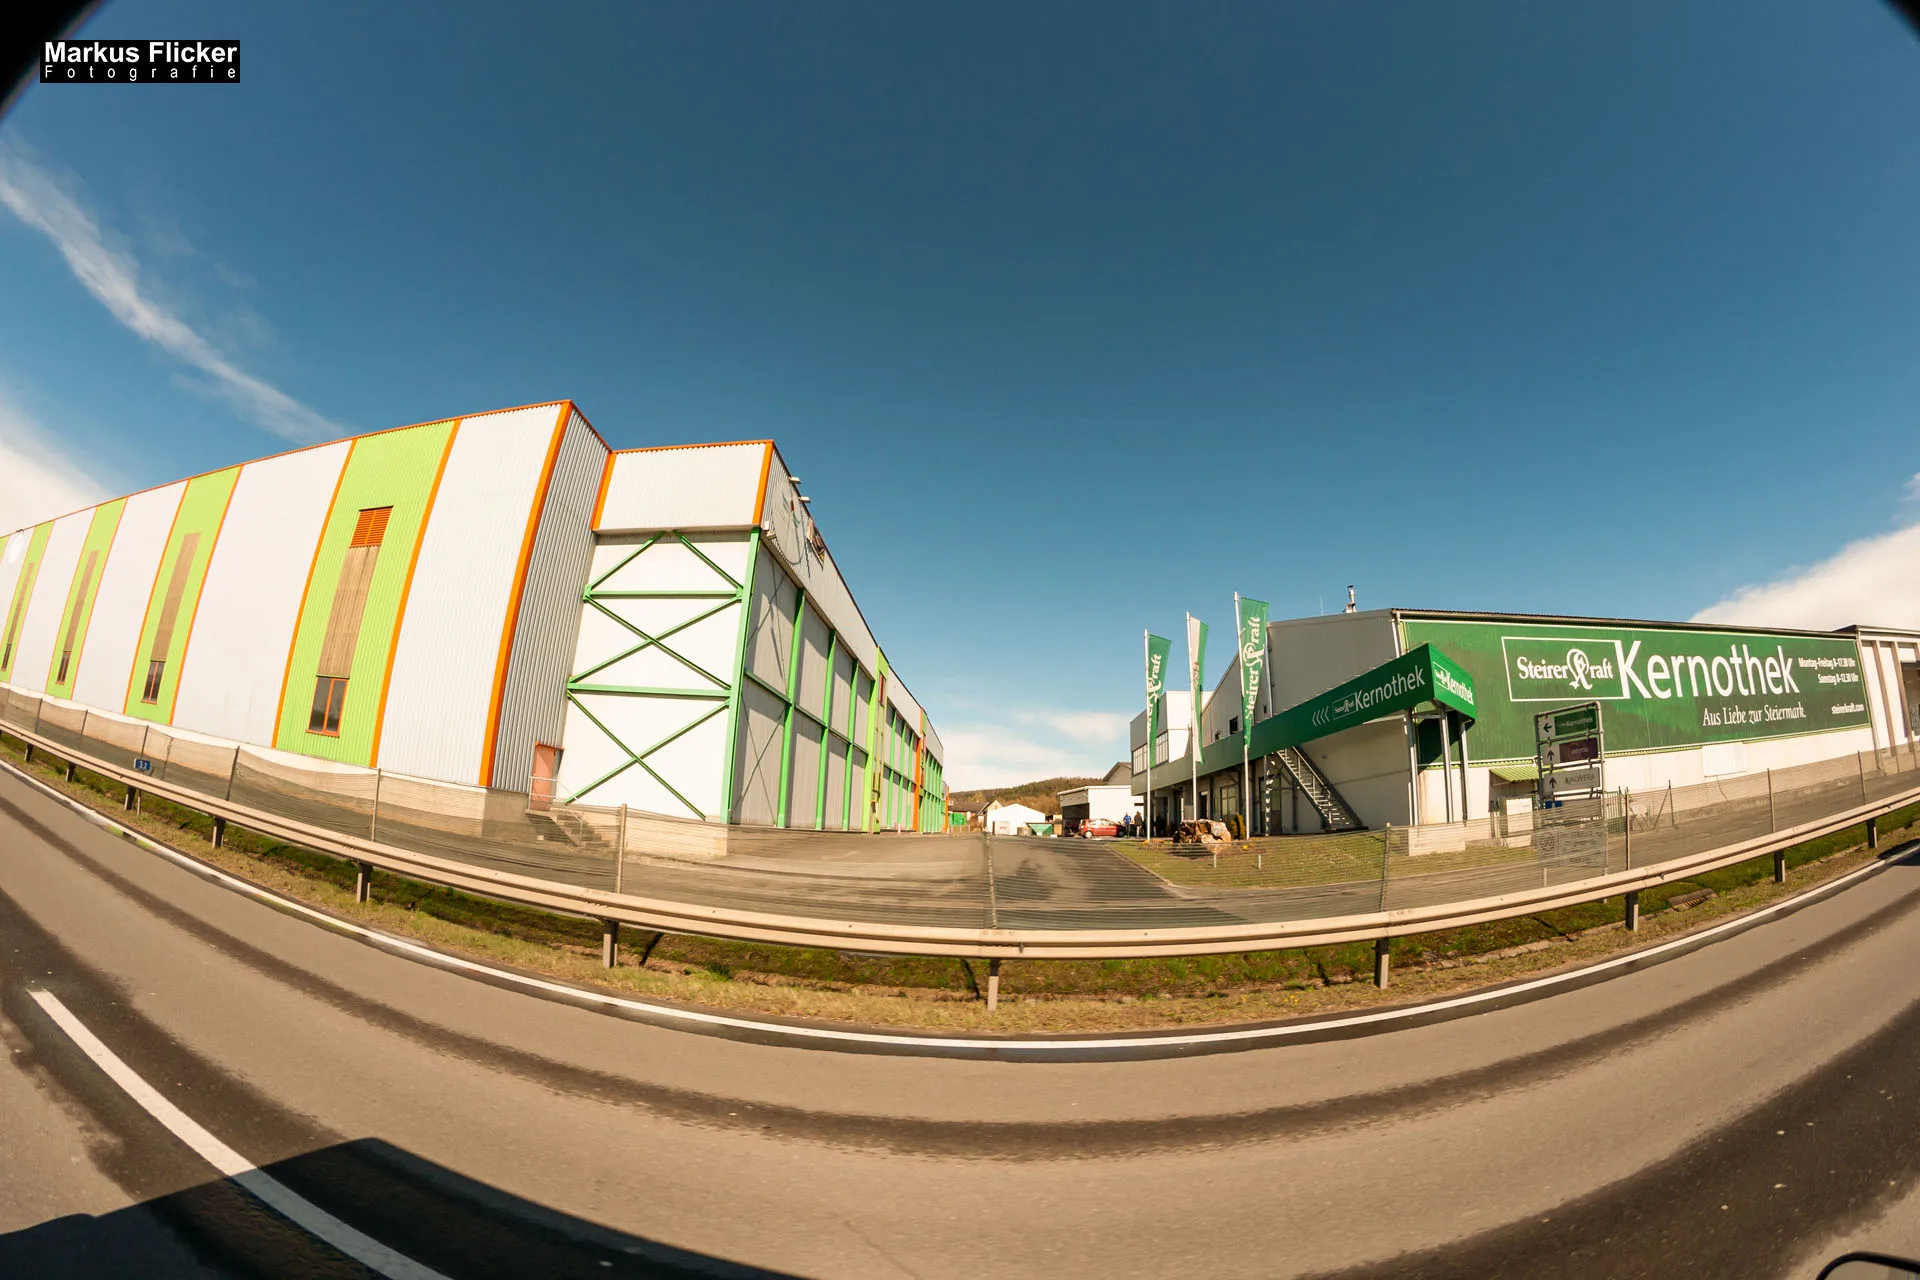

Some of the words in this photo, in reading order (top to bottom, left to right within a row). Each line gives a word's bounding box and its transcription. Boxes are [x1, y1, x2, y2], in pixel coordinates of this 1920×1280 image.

[1354, 664, 1426, 711] Kernothek
[1446, 671, 1474, 706] Kernothek
[1614, 640, 1800, 699] Kernothek
[1702, 707, 1721, 726] Aus
[1722, 705, 1747, 725] Liebe
[1748, 709, 1763, 724] zur
